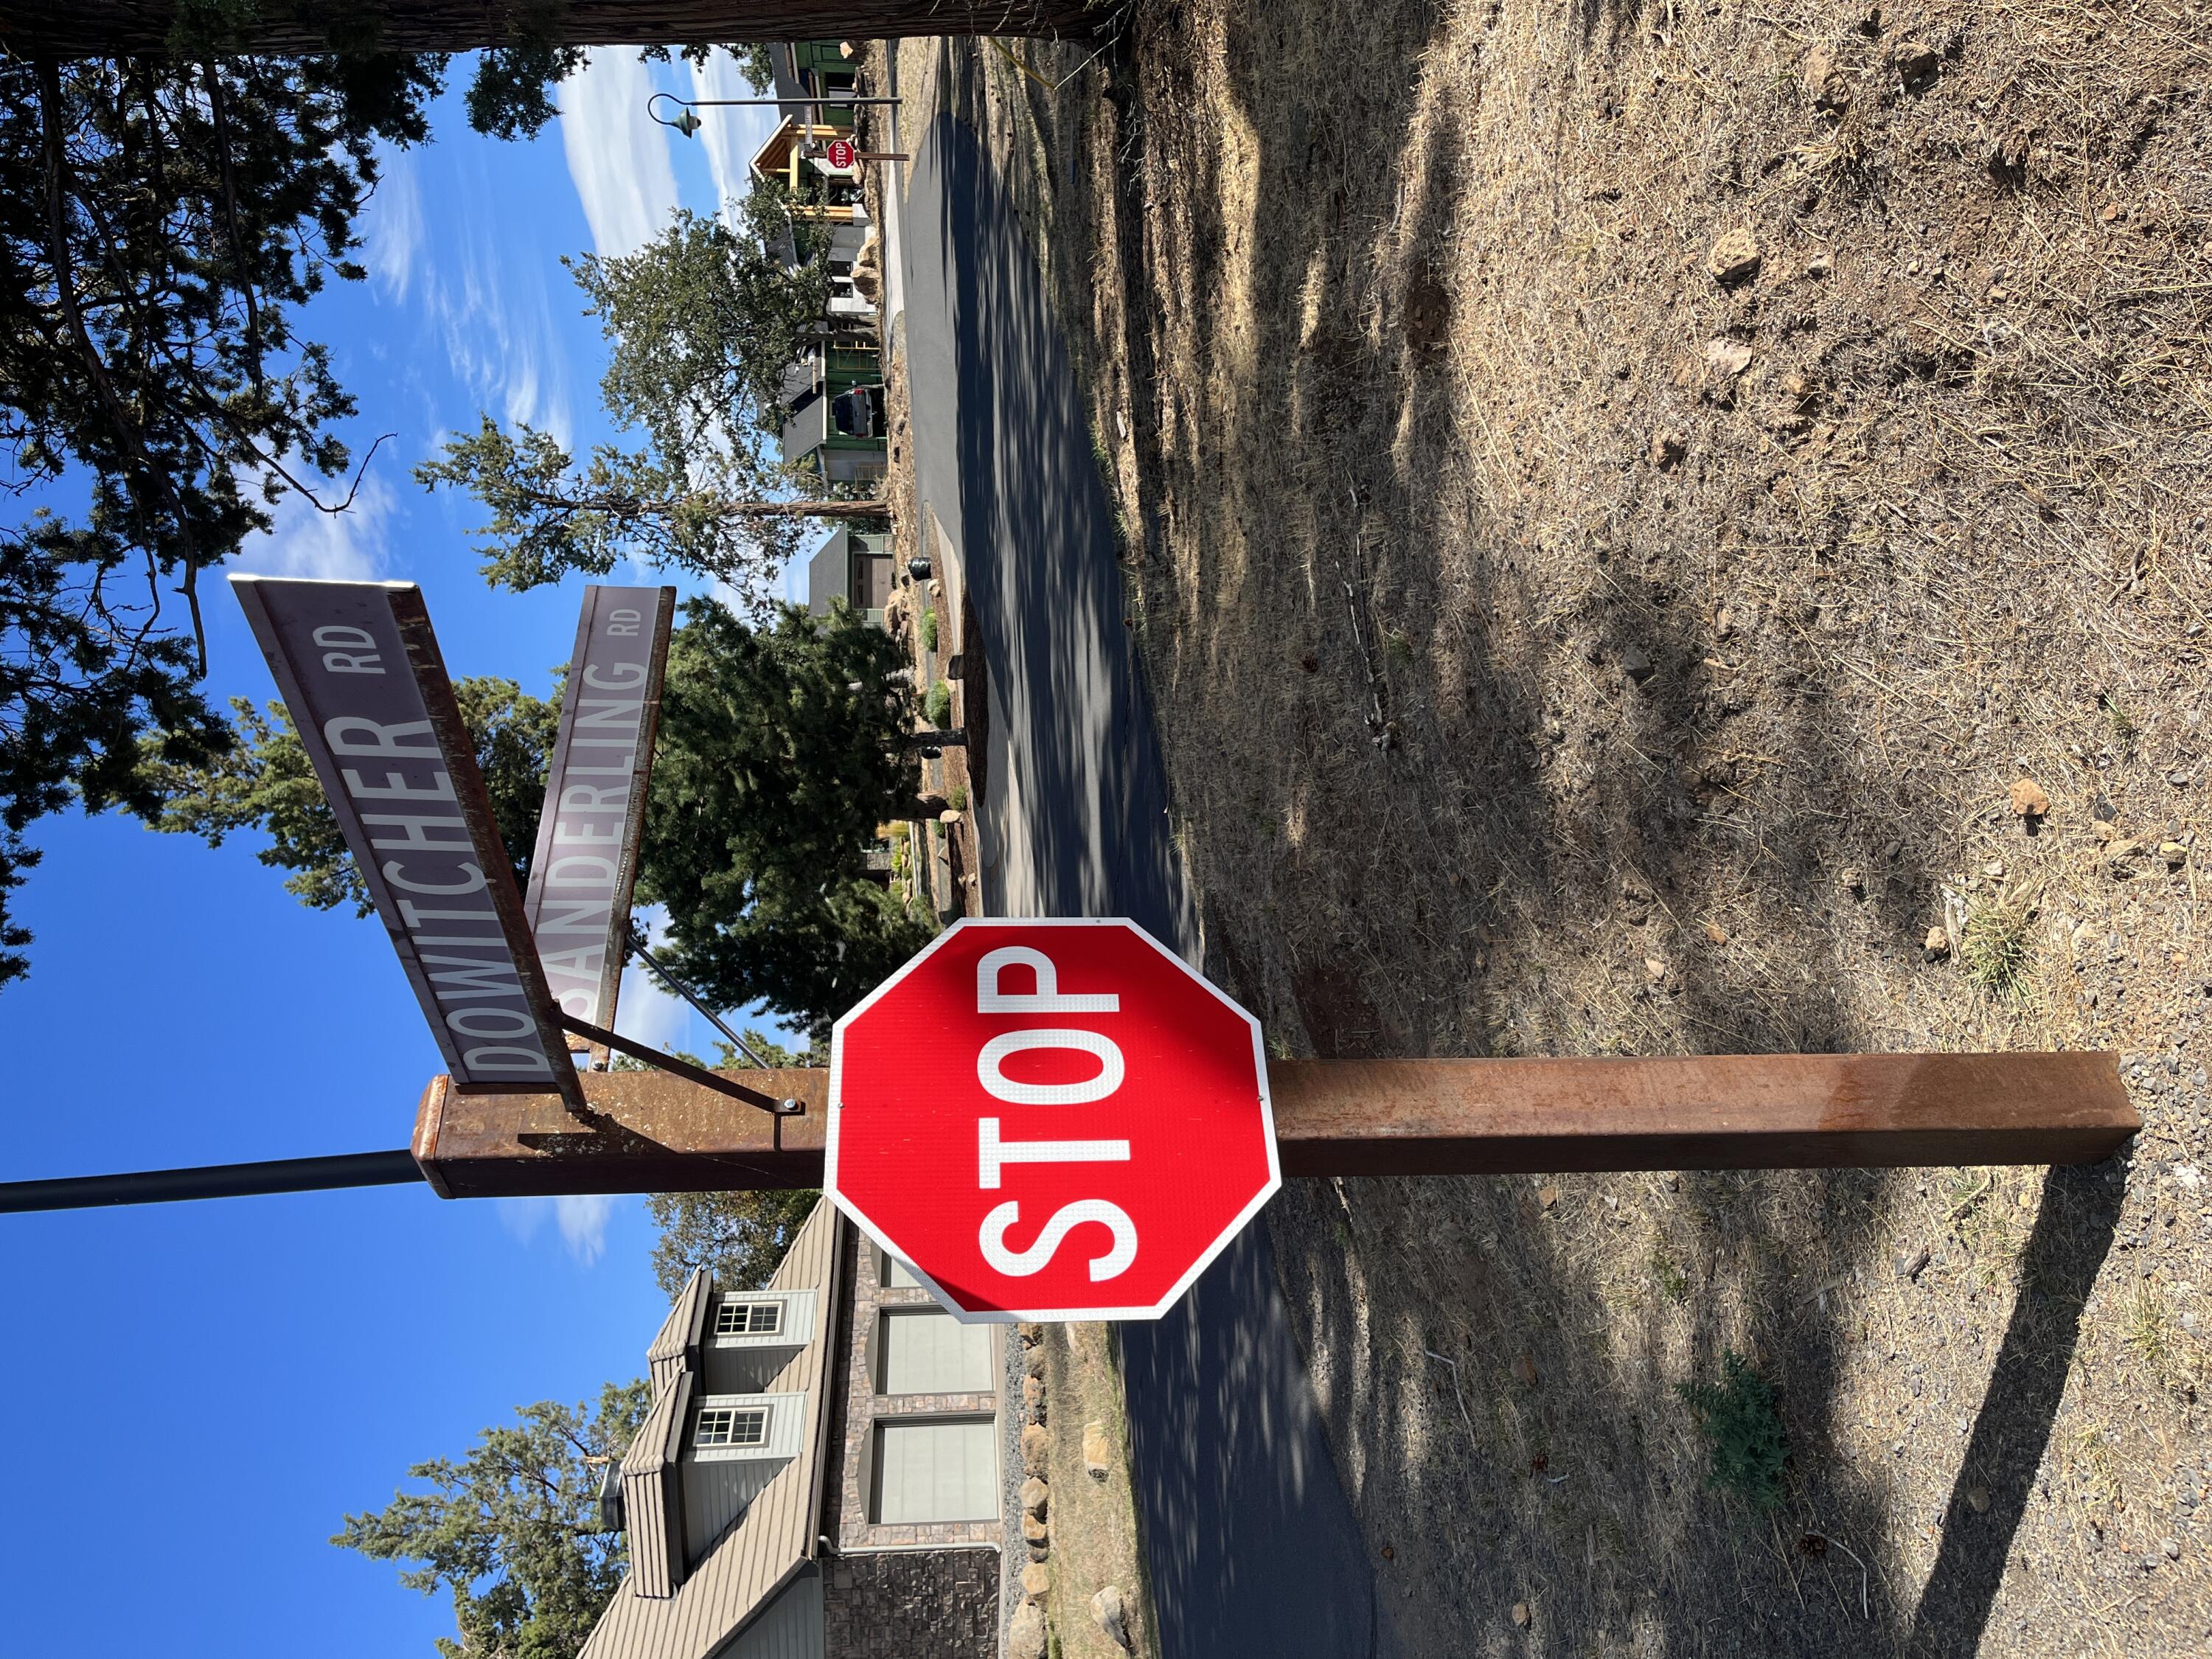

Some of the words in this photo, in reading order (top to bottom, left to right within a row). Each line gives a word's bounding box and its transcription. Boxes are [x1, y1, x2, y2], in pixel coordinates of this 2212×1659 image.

[835, 142, 846, 167] STOP
[606, 608, 641, 636] RD
[312, 625, 386, 674] RD
[323, 716, 552, 1071] DOWITCHER
[976, 945, 1138, 1282] STOP
